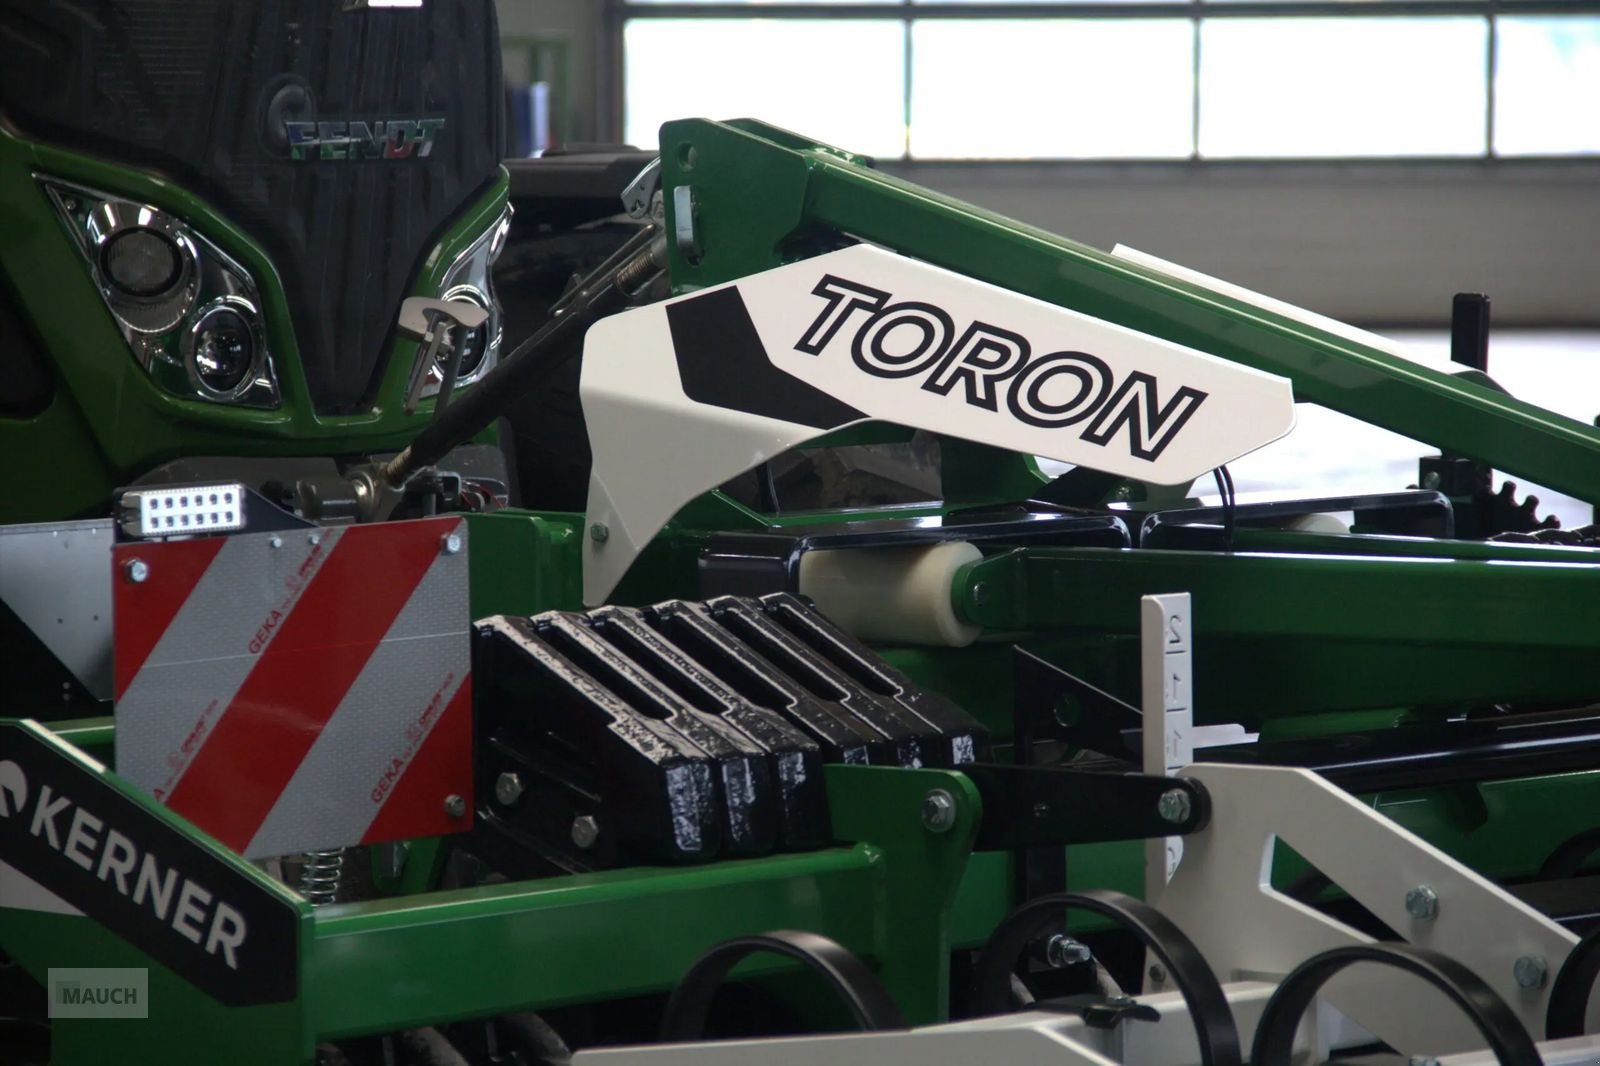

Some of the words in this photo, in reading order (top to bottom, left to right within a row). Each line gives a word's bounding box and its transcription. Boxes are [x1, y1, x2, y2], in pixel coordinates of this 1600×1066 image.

[285, 118, 446, 161] FENDT
[793, 273, 1209, 463] TORON
[248, 609, 283, 655] GEKA
[371, 756, 404, 803] GEKA
[29, 784, 248, 971] KERNER
